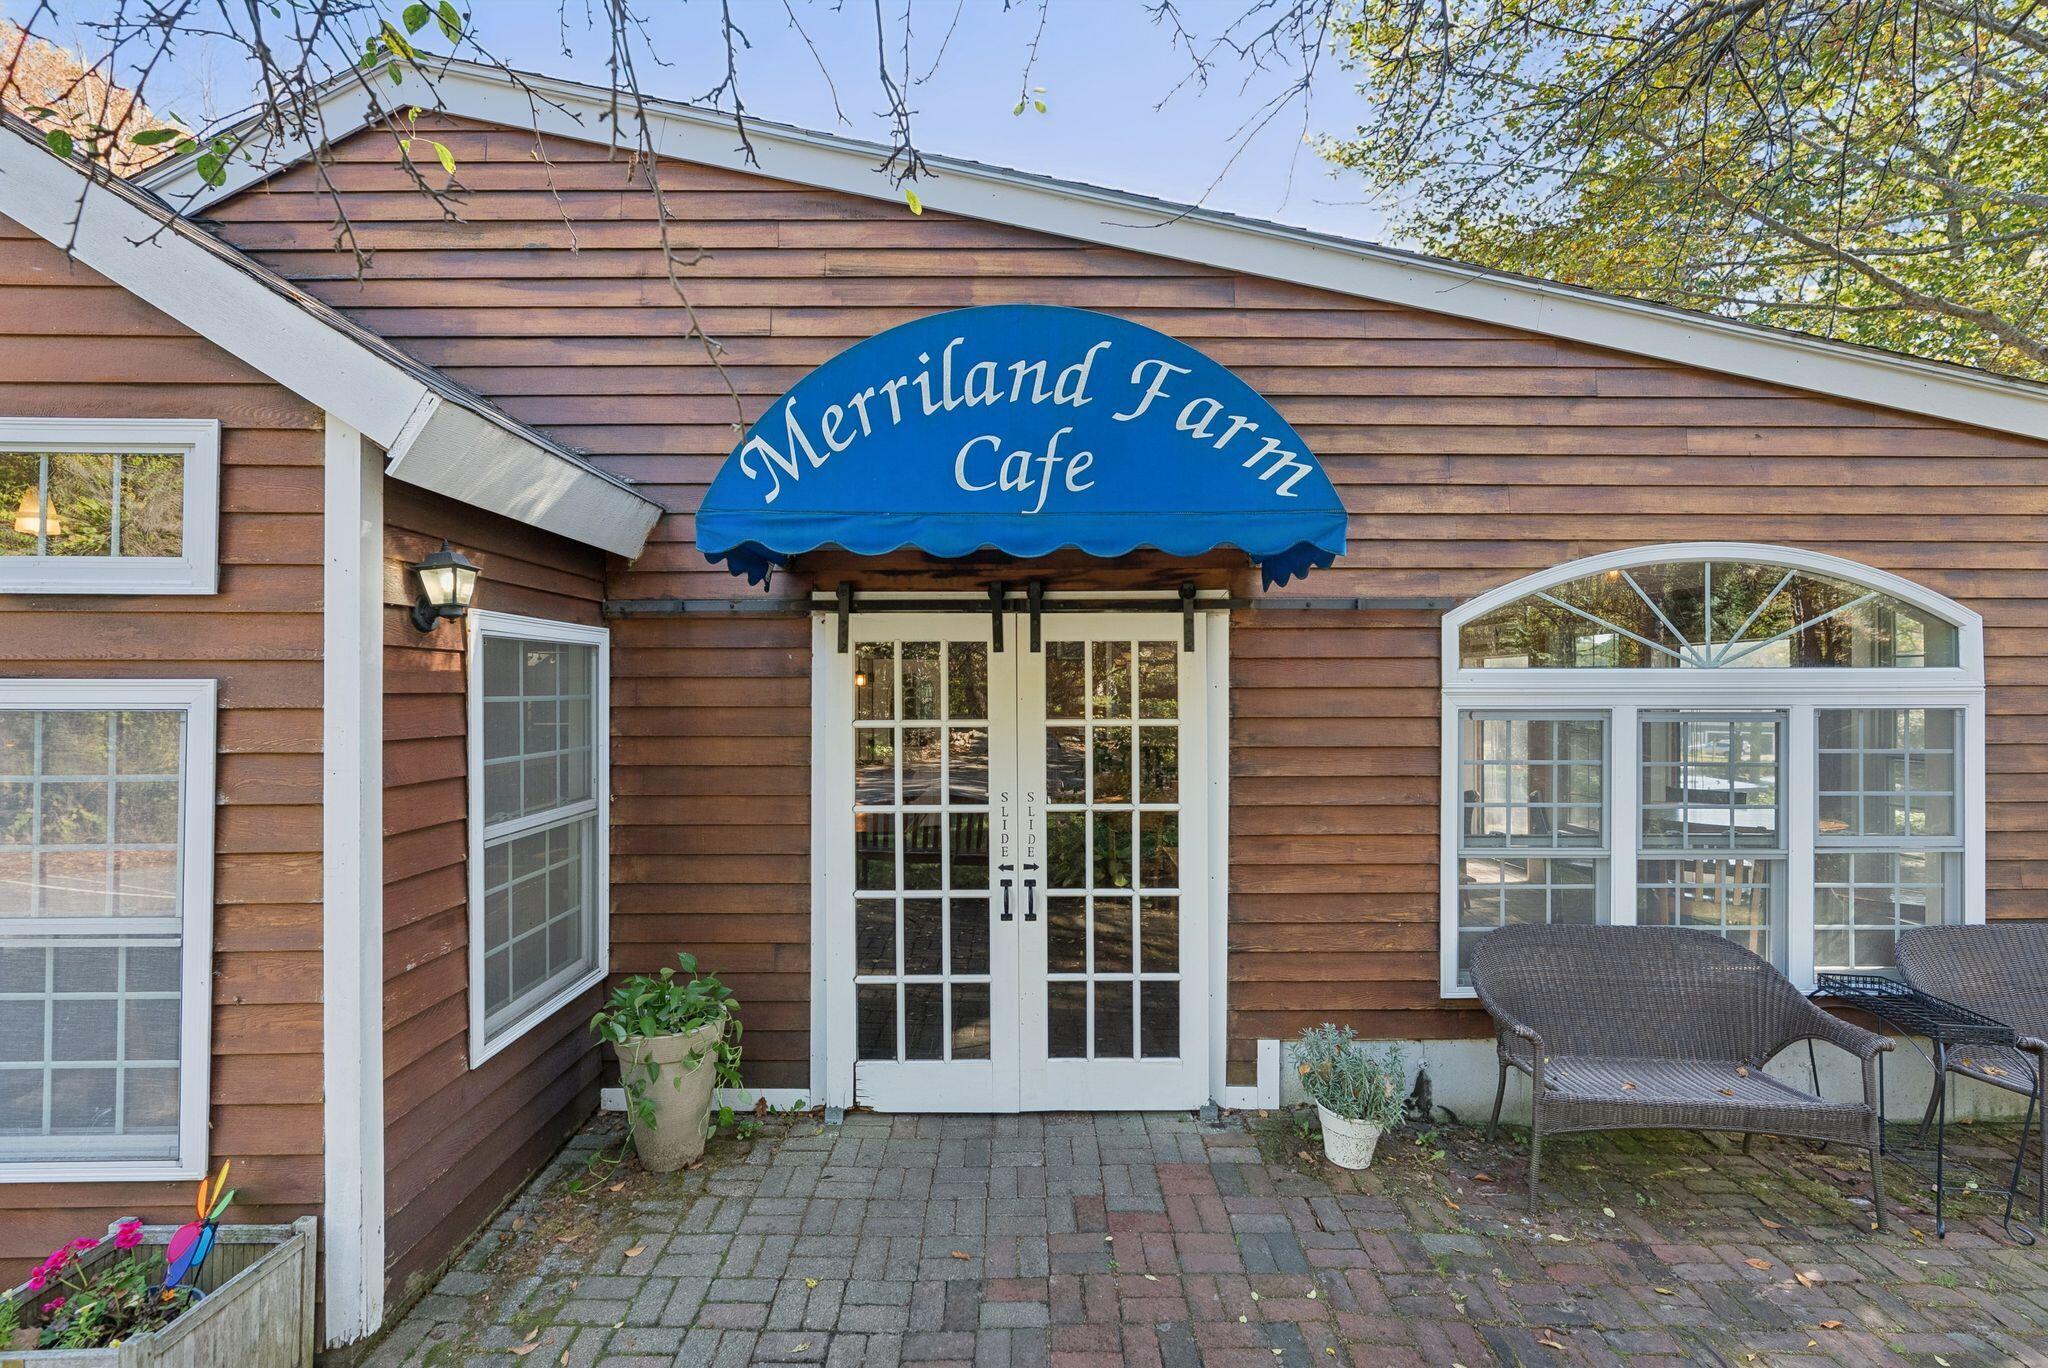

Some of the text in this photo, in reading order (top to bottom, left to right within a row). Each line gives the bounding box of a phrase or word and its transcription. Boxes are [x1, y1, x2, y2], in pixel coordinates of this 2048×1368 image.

[740, 337, 1314, 503] Merriland Farm
[955, 427, 1095, 514] Cafe
[1001, 792, 1009, 857] SLIDE
[1027, 792, 1036, 857] SLIDE
